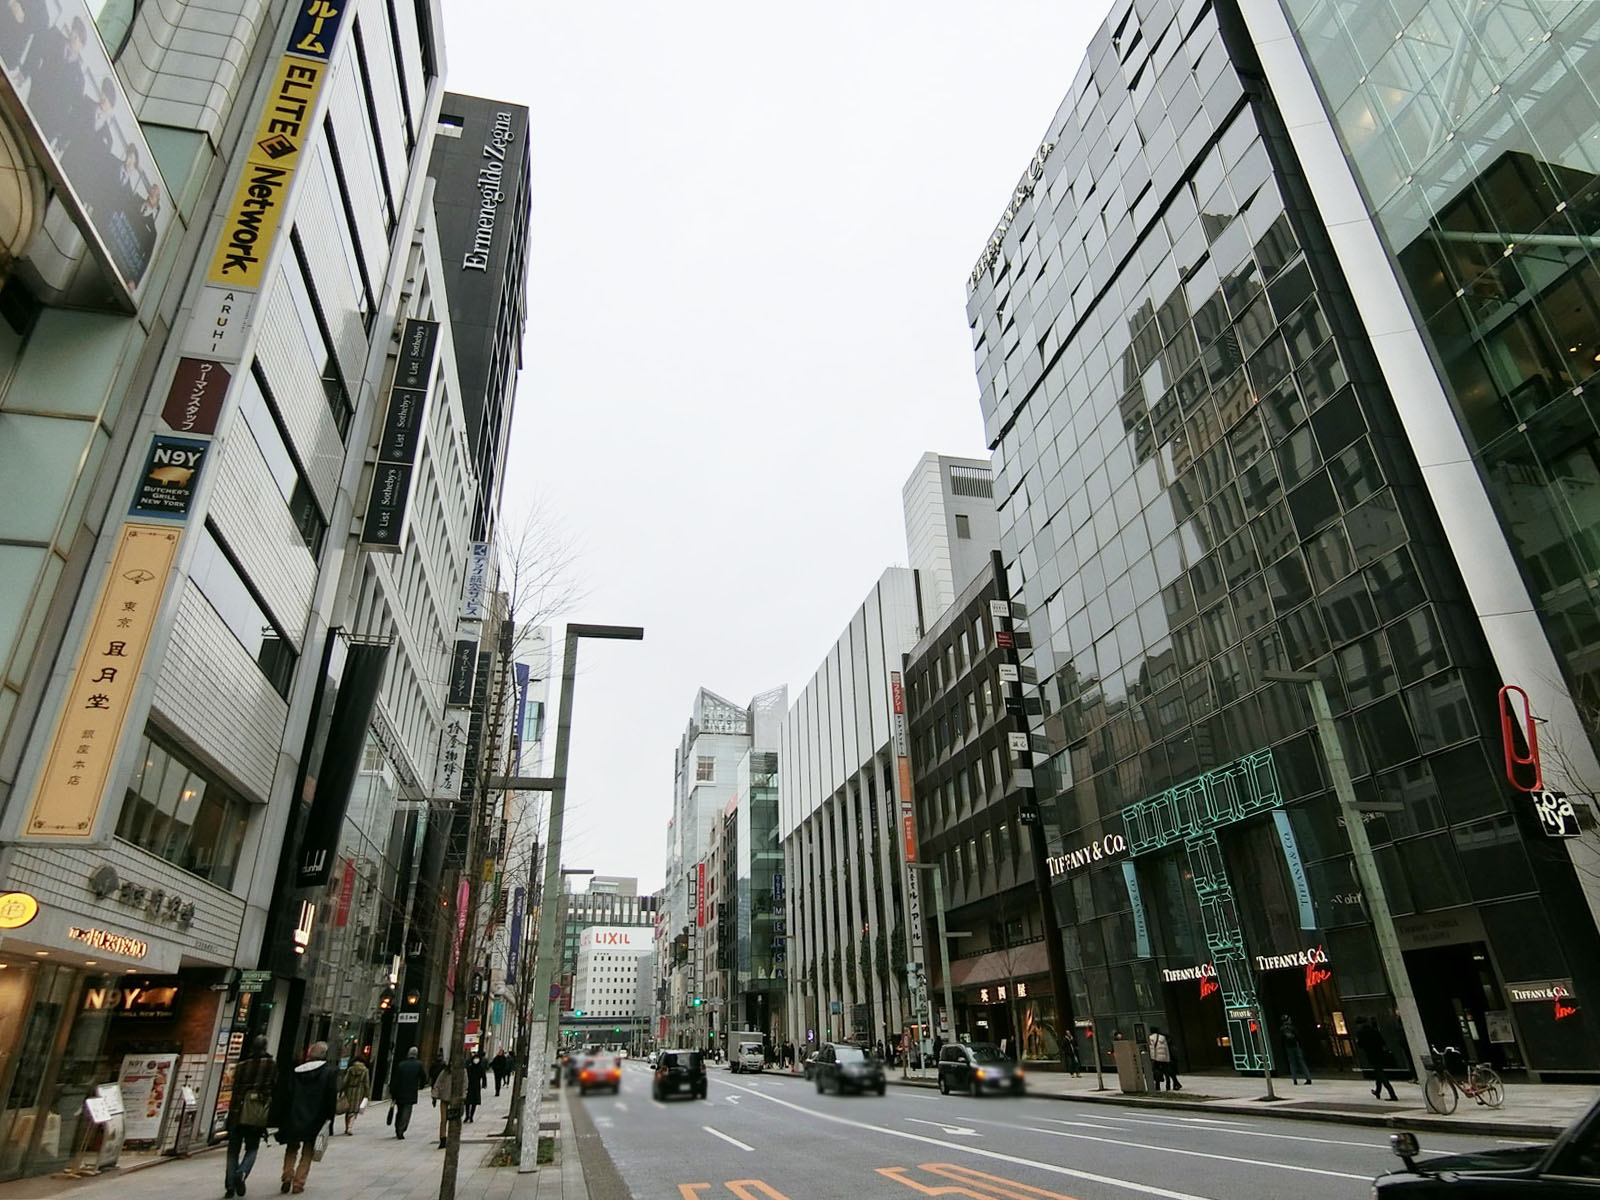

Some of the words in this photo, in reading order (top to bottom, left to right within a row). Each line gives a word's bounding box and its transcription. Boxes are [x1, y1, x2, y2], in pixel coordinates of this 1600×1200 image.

[268, 65, 317, 137] ELITE
[483, 111, 515, 160] Zegna
[222, 167, 286, 275] Network.
[463, 161, 505, 272] Ermenegildo
[212, 292, 234, 352] ARUHI
[410, 325, 424, 357] Sotheby's
[408, 361, 419, 375] List
[182, 363, 213, 431] ウーマンスタッフ
[397, 394, 411, 428] Sotheby's
[395, 433, 404, 448] List
[153, 449, 201, 466] N9Y
[143, 486, 190, 496] BUTCHER'S
[152, 492, 178, 501] GRILL
[381, 468, 396, 506] Sotheby's
[140, 497, 162, 505] NEW
[163, 499, 186, 507] YORK
[379, 512, 391, 527] List
[121, 601, 138, 628] 東京
[302, 849, 327, 873] dunhill
[1046, 846, 1092, 877] TIFFANY
[1092, 841, 1103, 860] &
[595, 932, 630, 944] LIXIL
[775, 907, 784, 977] MELSA
[1256, 953, 1298, 970] TIFFANY
[1298, 951, 1308, 965] &
[1163, 968, 1195, 982] TIFFANY
[1195, 966, 1203, 978] &
[1512, 989, 1545, 1000] TIFFANY
[1546, 988, 1553, 997] &
